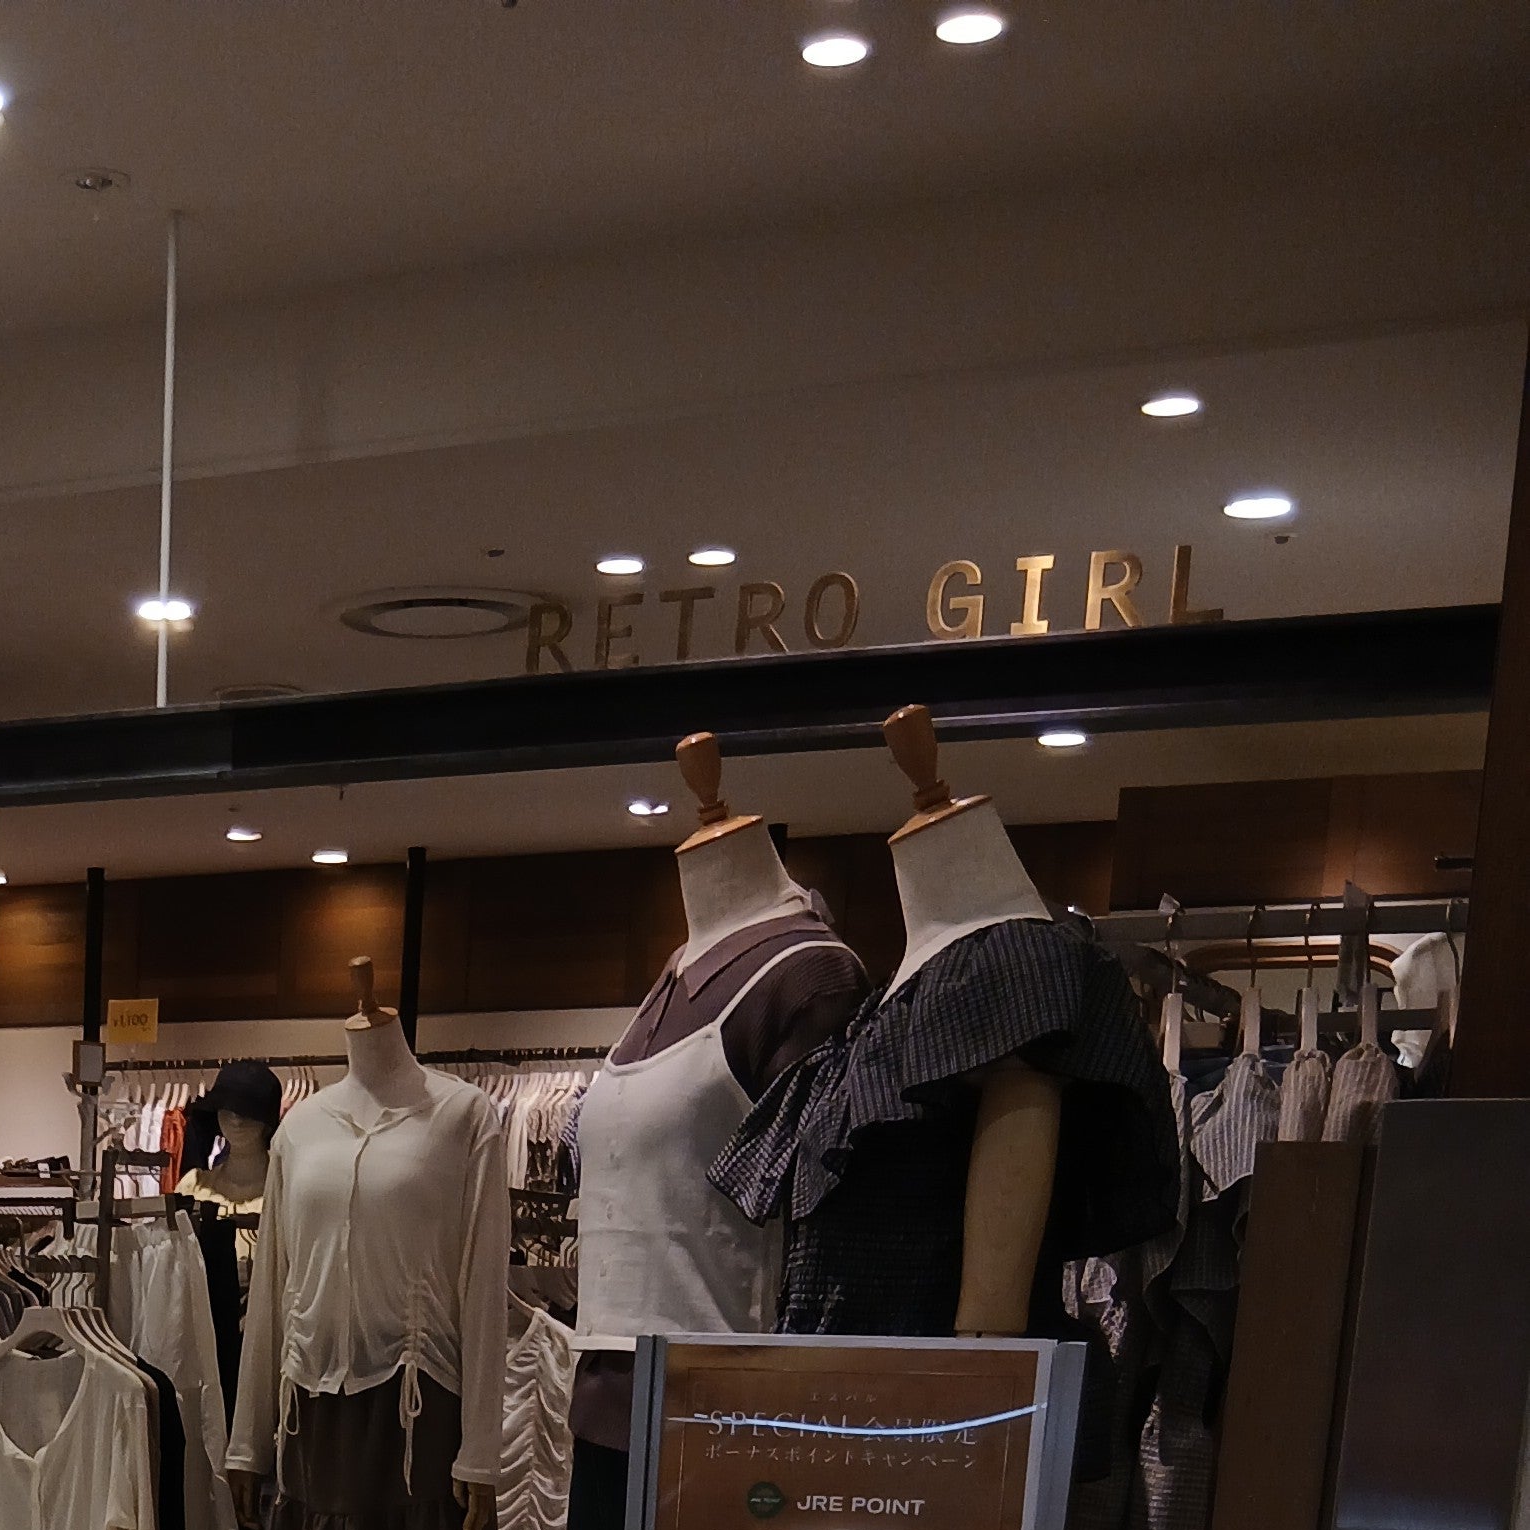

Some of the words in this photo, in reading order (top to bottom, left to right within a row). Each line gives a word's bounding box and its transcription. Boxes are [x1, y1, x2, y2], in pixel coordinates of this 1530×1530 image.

[525, 571, 859, 674] RETRO
[926, 545, 1224, 639] GIRL
[797, 1495, 843, 1512] JRE
[851, 1496, 925, 1516] POINT
